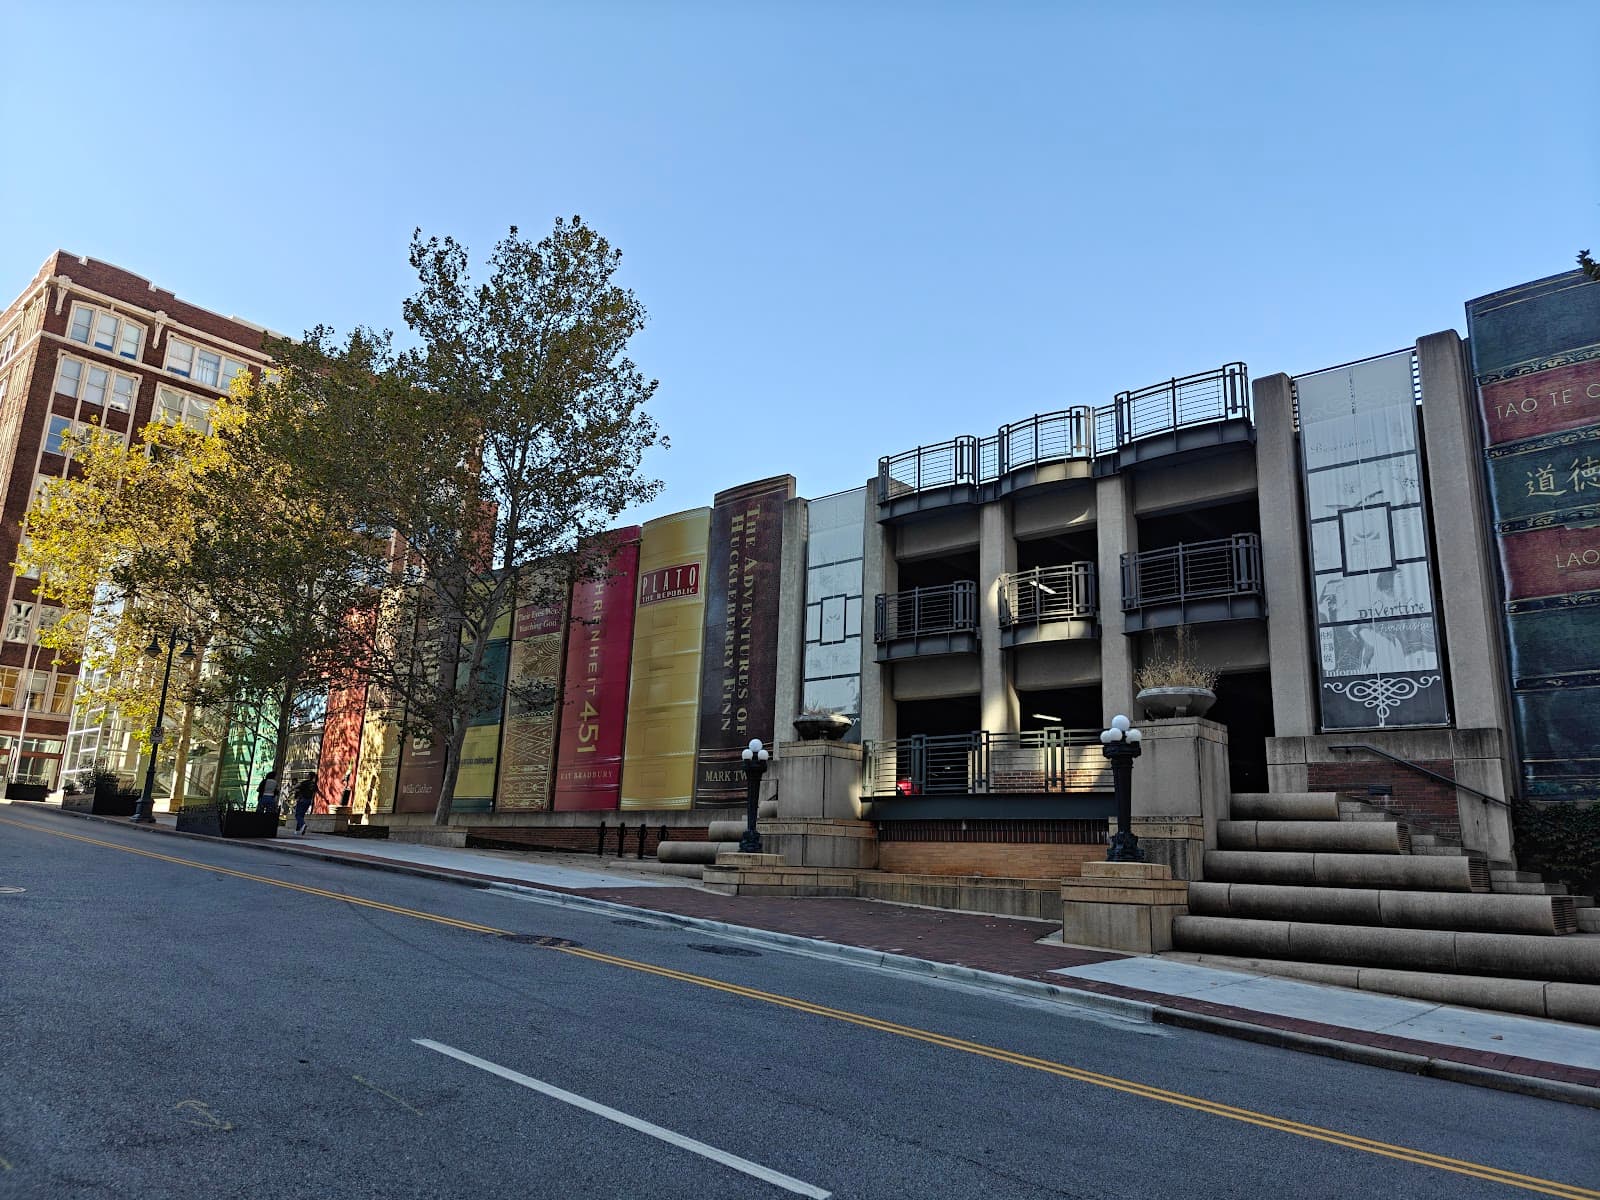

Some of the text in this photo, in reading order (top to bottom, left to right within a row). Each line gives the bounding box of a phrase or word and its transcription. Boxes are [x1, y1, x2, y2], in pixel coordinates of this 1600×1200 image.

[1495, 398, 1538, 419] TAO
[1550, 389, 1572, 407] TE
[1555, 550, 1600, 568] LAO
[642, 567, 696, 596] PLATO
[642, 587, 695, 603] THE REPUBLIC
[721, 514, 744, 731] HUCKLEBERRY FINN
[736, 503, 761, 736] THE ADVENTURES OF
[577, 572, 604, 753] HRENHEIT 451
[705, 770, 731, 782] MARK
